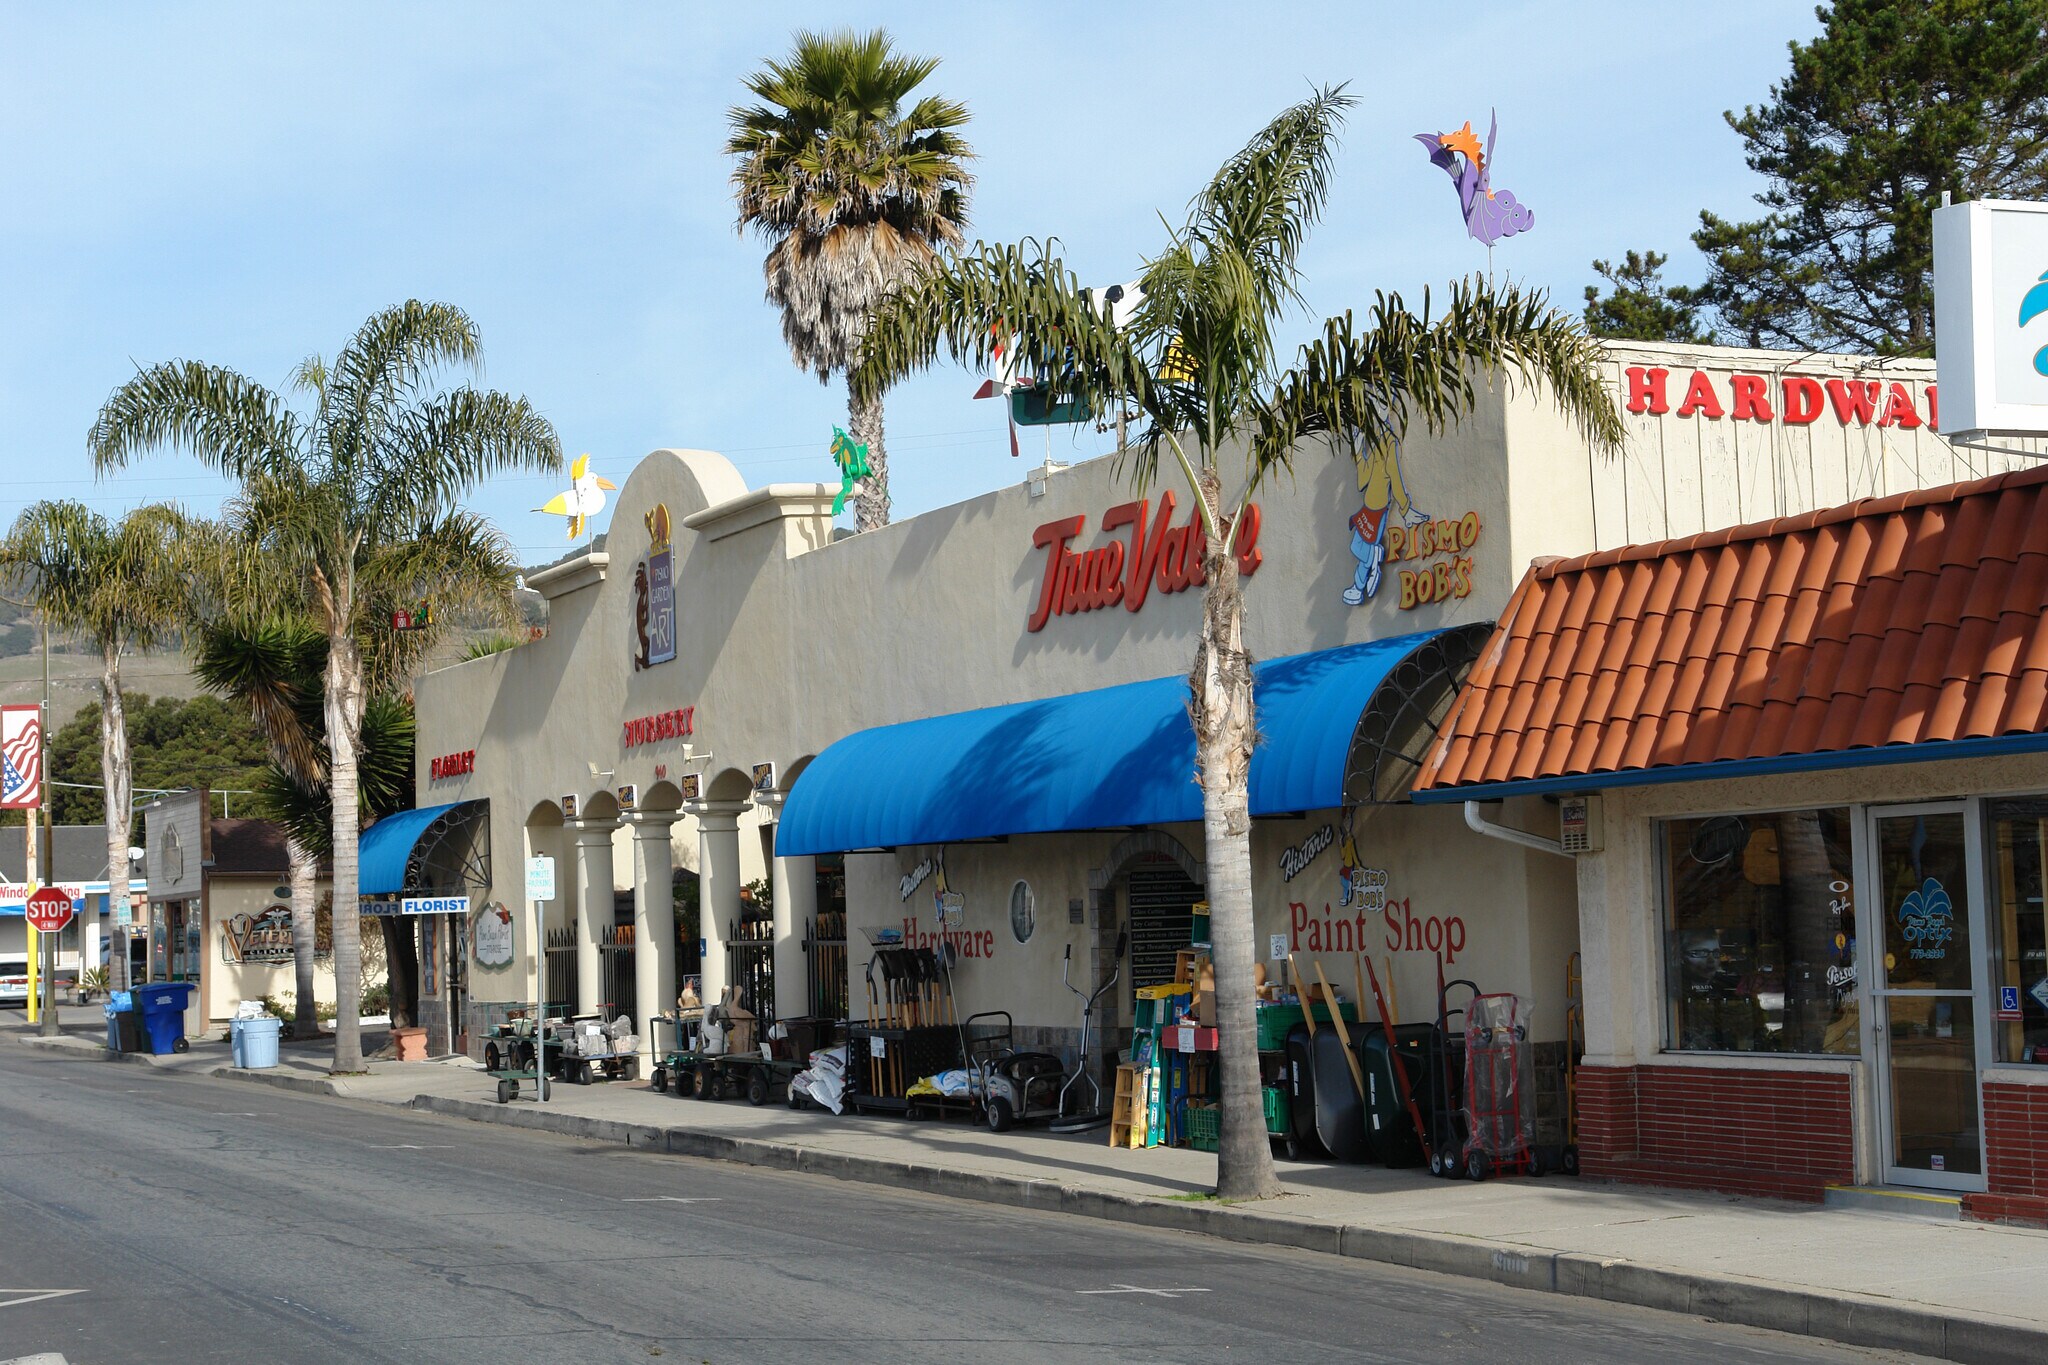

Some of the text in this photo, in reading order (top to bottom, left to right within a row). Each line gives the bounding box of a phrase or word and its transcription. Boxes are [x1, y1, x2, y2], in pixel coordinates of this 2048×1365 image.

[1386, 511, 1480, 563] PISMO
[1028, 489, 1262, 633] True Vale
[654, 565, 669, 582] PISMO
[1398, 555, 1474, 610] BOB'S
[651, 585, 671, 604] GARDEN
[651, 606, 673, 649] ART
[624, 705, 695, 748] NURSERY
[431, 749, 475, 781] FLORIST
[1279, 824, 1335, 882] Historic
[1353, 870, 1387, 888] PISMO
[0, 886, 28, 898] Windo
[1356, 889, 1385, 911] BOB'S
[28, 901, 70, 918] STOP
[405, 899, 467, 913] FLORIST
[903, 917, 994, 958] Hardware
[1288, 898, 1466, 964] Paint Shop
[1903, 926, 1953, 948] Optix
[250, 948, 289, 956] CLINIC
[1827, 961, 1858, 985] Persol
